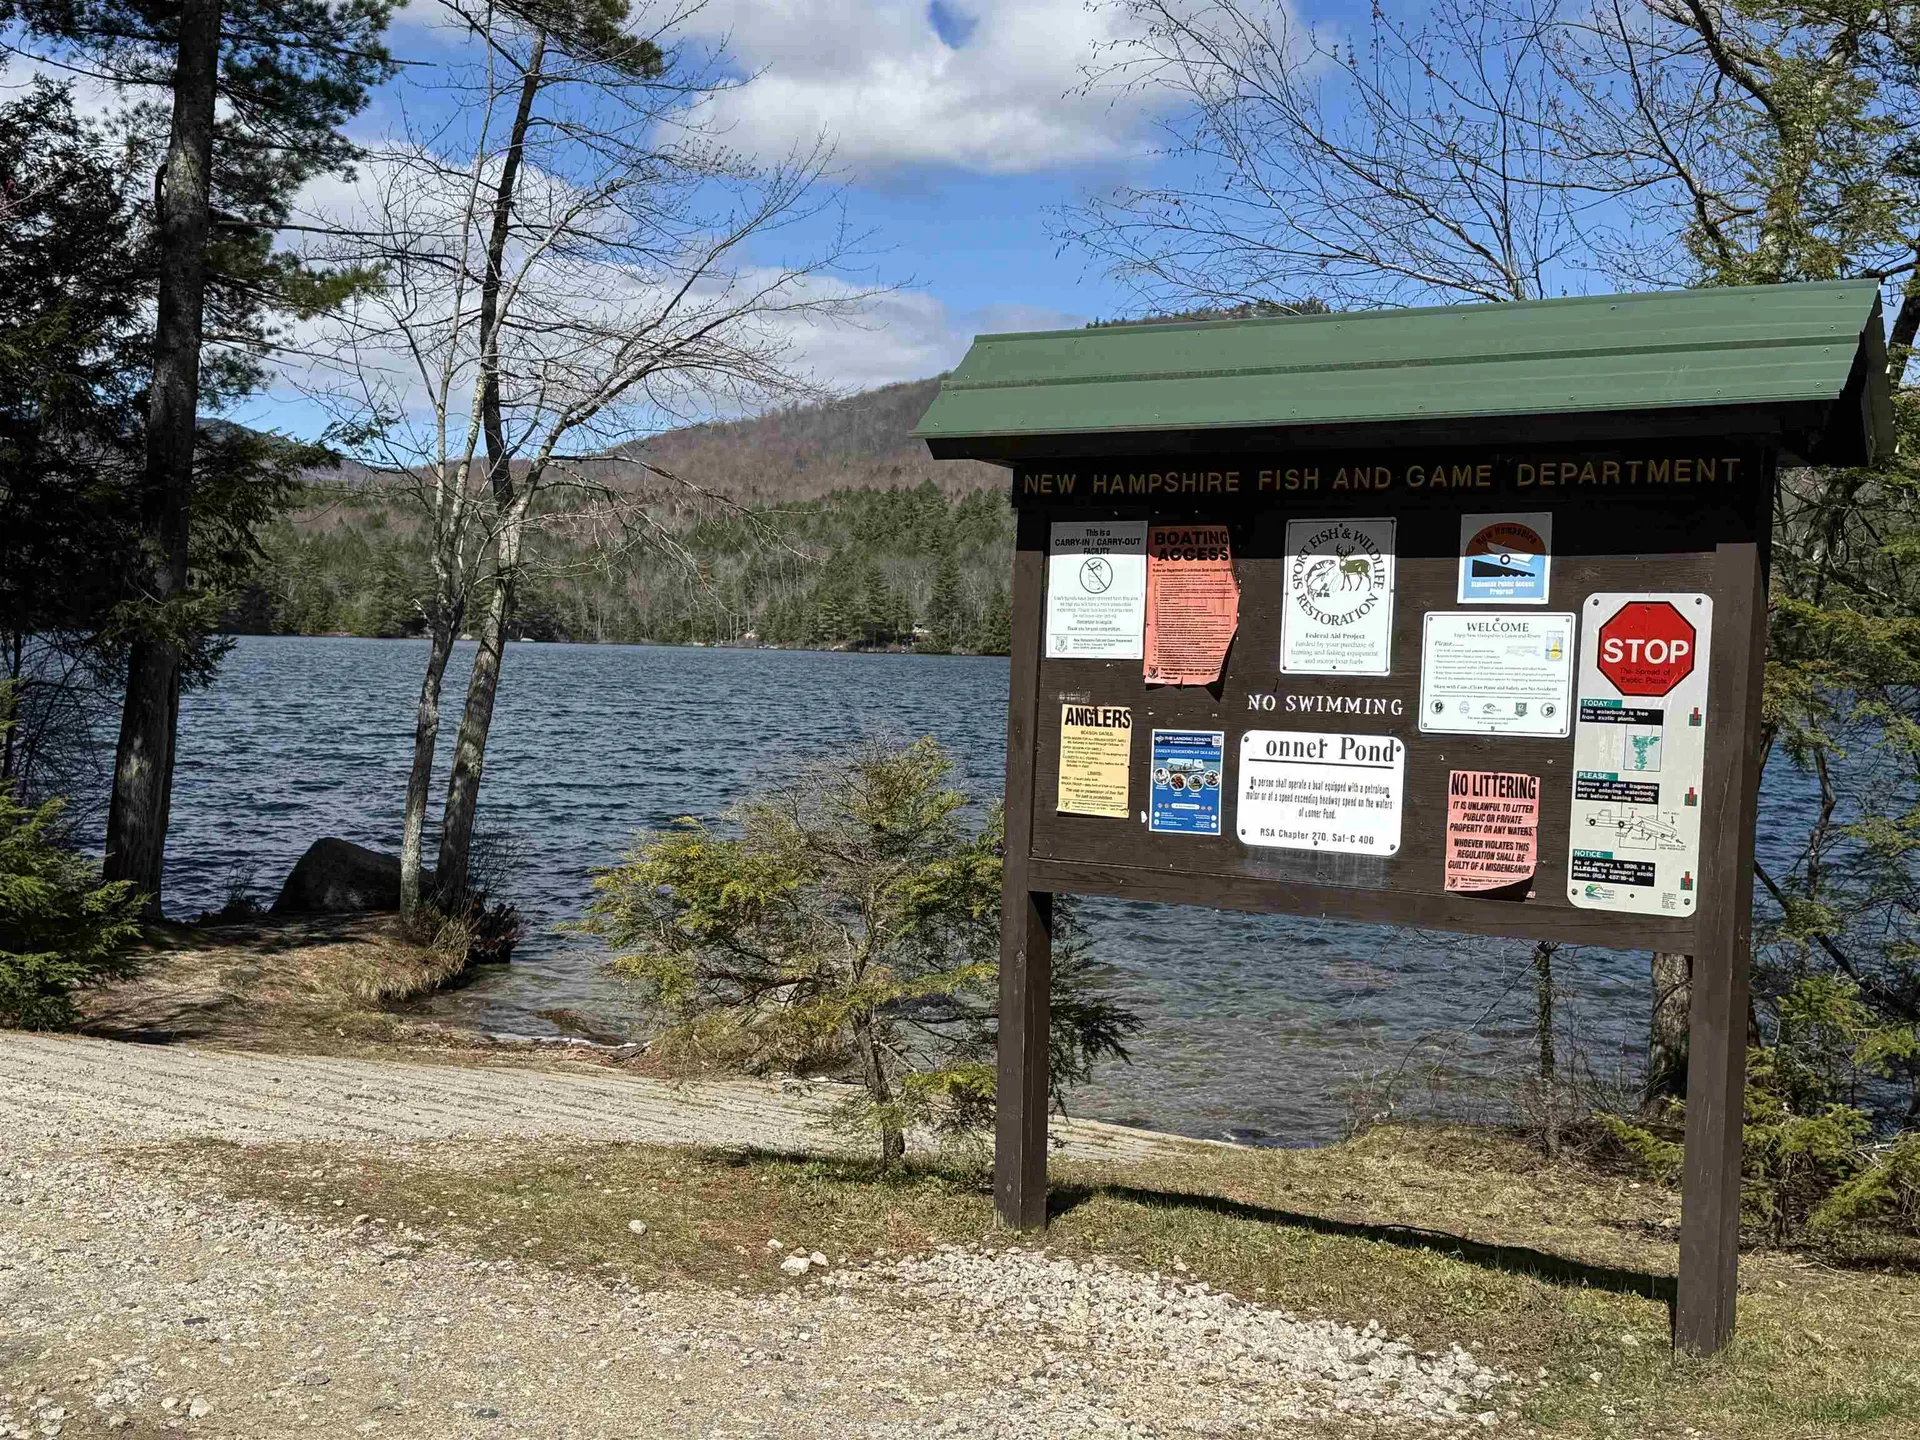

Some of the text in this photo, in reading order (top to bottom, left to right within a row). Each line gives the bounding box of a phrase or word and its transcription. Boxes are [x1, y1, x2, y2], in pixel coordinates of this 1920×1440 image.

[1024, 458, 1741, 494] NEW HAMPSHIRE FISH AND GAME DEPARTMENT
[1086, 529, 1099, 537] This
[1099, 529, 1106, 537] is
[1154, 531, 1229, 546] BOATING
[1055, 538, 1090, 546] CARRY-IN
[1097, 538, 1141, 546] CARRY-OUT
[1083, 547, 1110, 555] FACILITY
[1158, 547, 1229, 561] ACCESS
[1292, 527, 1385, 590] SPORT FISH & WILDLIFE
[1296, 593, 1379, 626] RESTORATION
[1466, 622, 1530, 632] WELCOME
[1602, 637, 1690, 665] STOP
[1620, 667, 1671, 676] The Spread of
[1247, 694, 1404, 716] NO SWIMMING
[1064, 707, 1131, 729] ANGLERS
[1340, 736, 1395, 763] Pond
[1451, 773, 1536, 800] NO LITTERING
[1629, 783, 1659, 791] fragments
[1611, 794, 1632, 802] leaving
[1452, 801, 1534, 814] IT IS UNLAWFUL TO LITTER
[1462, 812, 1523, 824] PUBLIC OR PRIVATE
[1449, 822, 1483, 833] PROPERTY
[1483, 824, 1492, 833] OR
[1493, 825, 1508, 835] ANY
[1260, 828, 1276, 838] RSA
[1278, 829, 1309, 841] Chapter
[1358, 835, 1375, 845] 400
[1454, 838, 1530, 852] WHOEVER VIOLATES THIS
[1456, 849, 1526, 862] REGULATION SHALL BE
[1447, 859, 1470, 870] GUILTY
[1470, 861, 1479, 871] OF
[1479, 862, 1484, 871] A
[1609, 868, 1634, 877] transport
